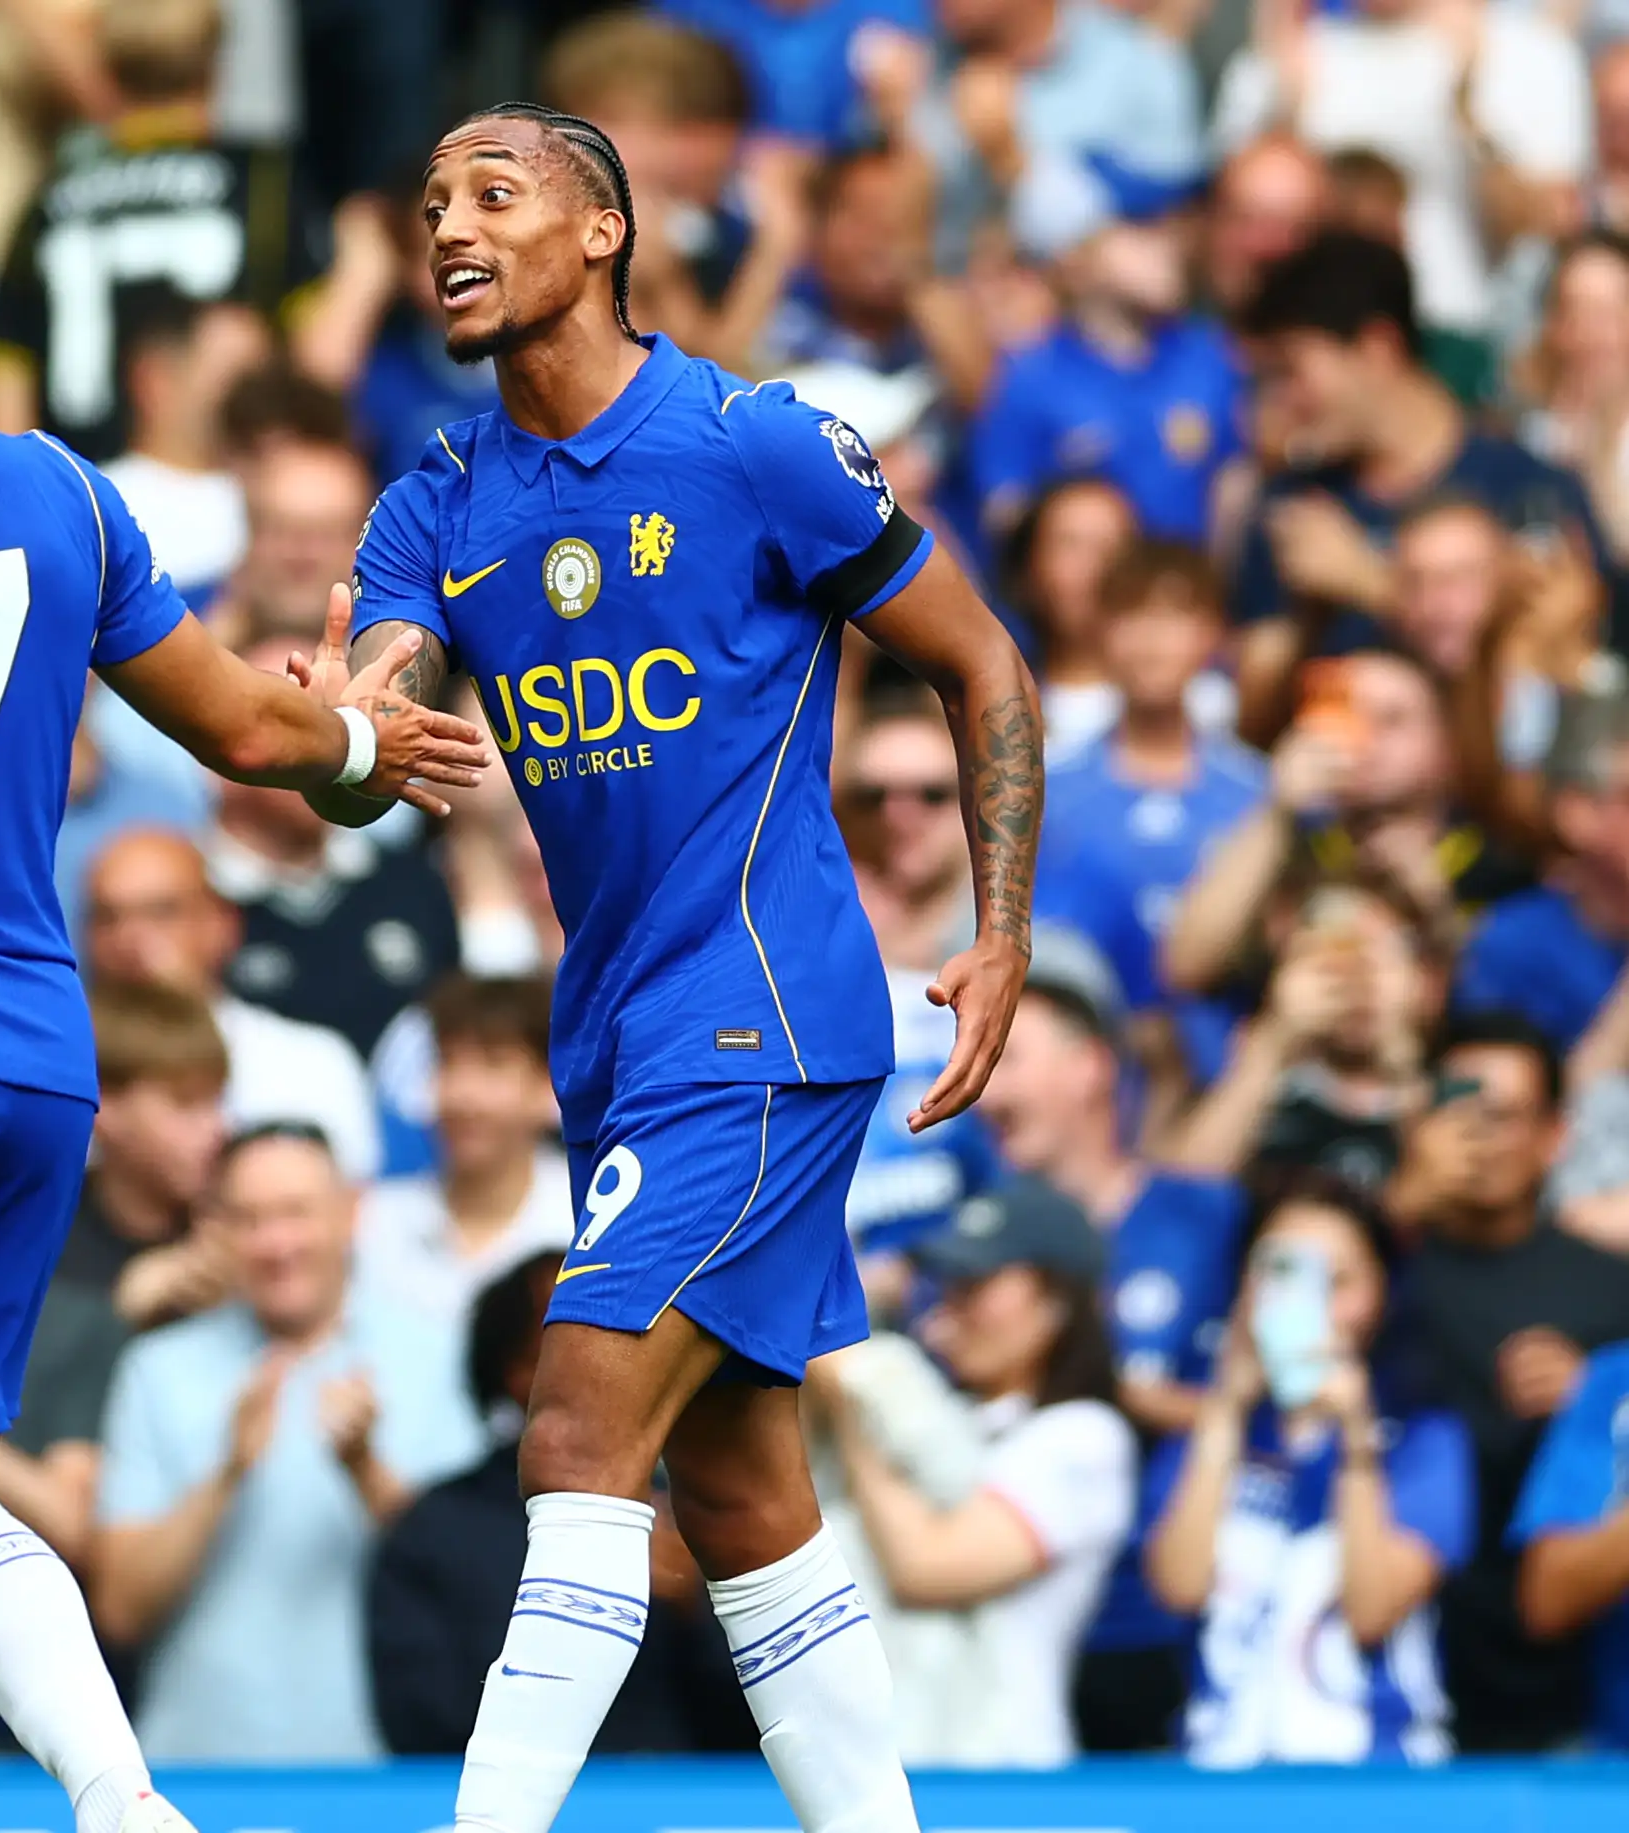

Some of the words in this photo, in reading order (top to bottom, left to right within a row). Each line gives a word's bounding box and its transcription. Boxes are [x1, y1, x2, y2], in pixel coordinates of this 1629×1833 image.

[546, 552, 560, 591] WORLD
[558, 544, 595, 585] CHAMPIONS
[560, 599, 583, 613] FIFA
[471, 648, 702, 753] USDC
[546, 757, 568, 780] BY
[575, 743, 654, 776] CIRCLE
[574, 1144, 642, 1251] 9
